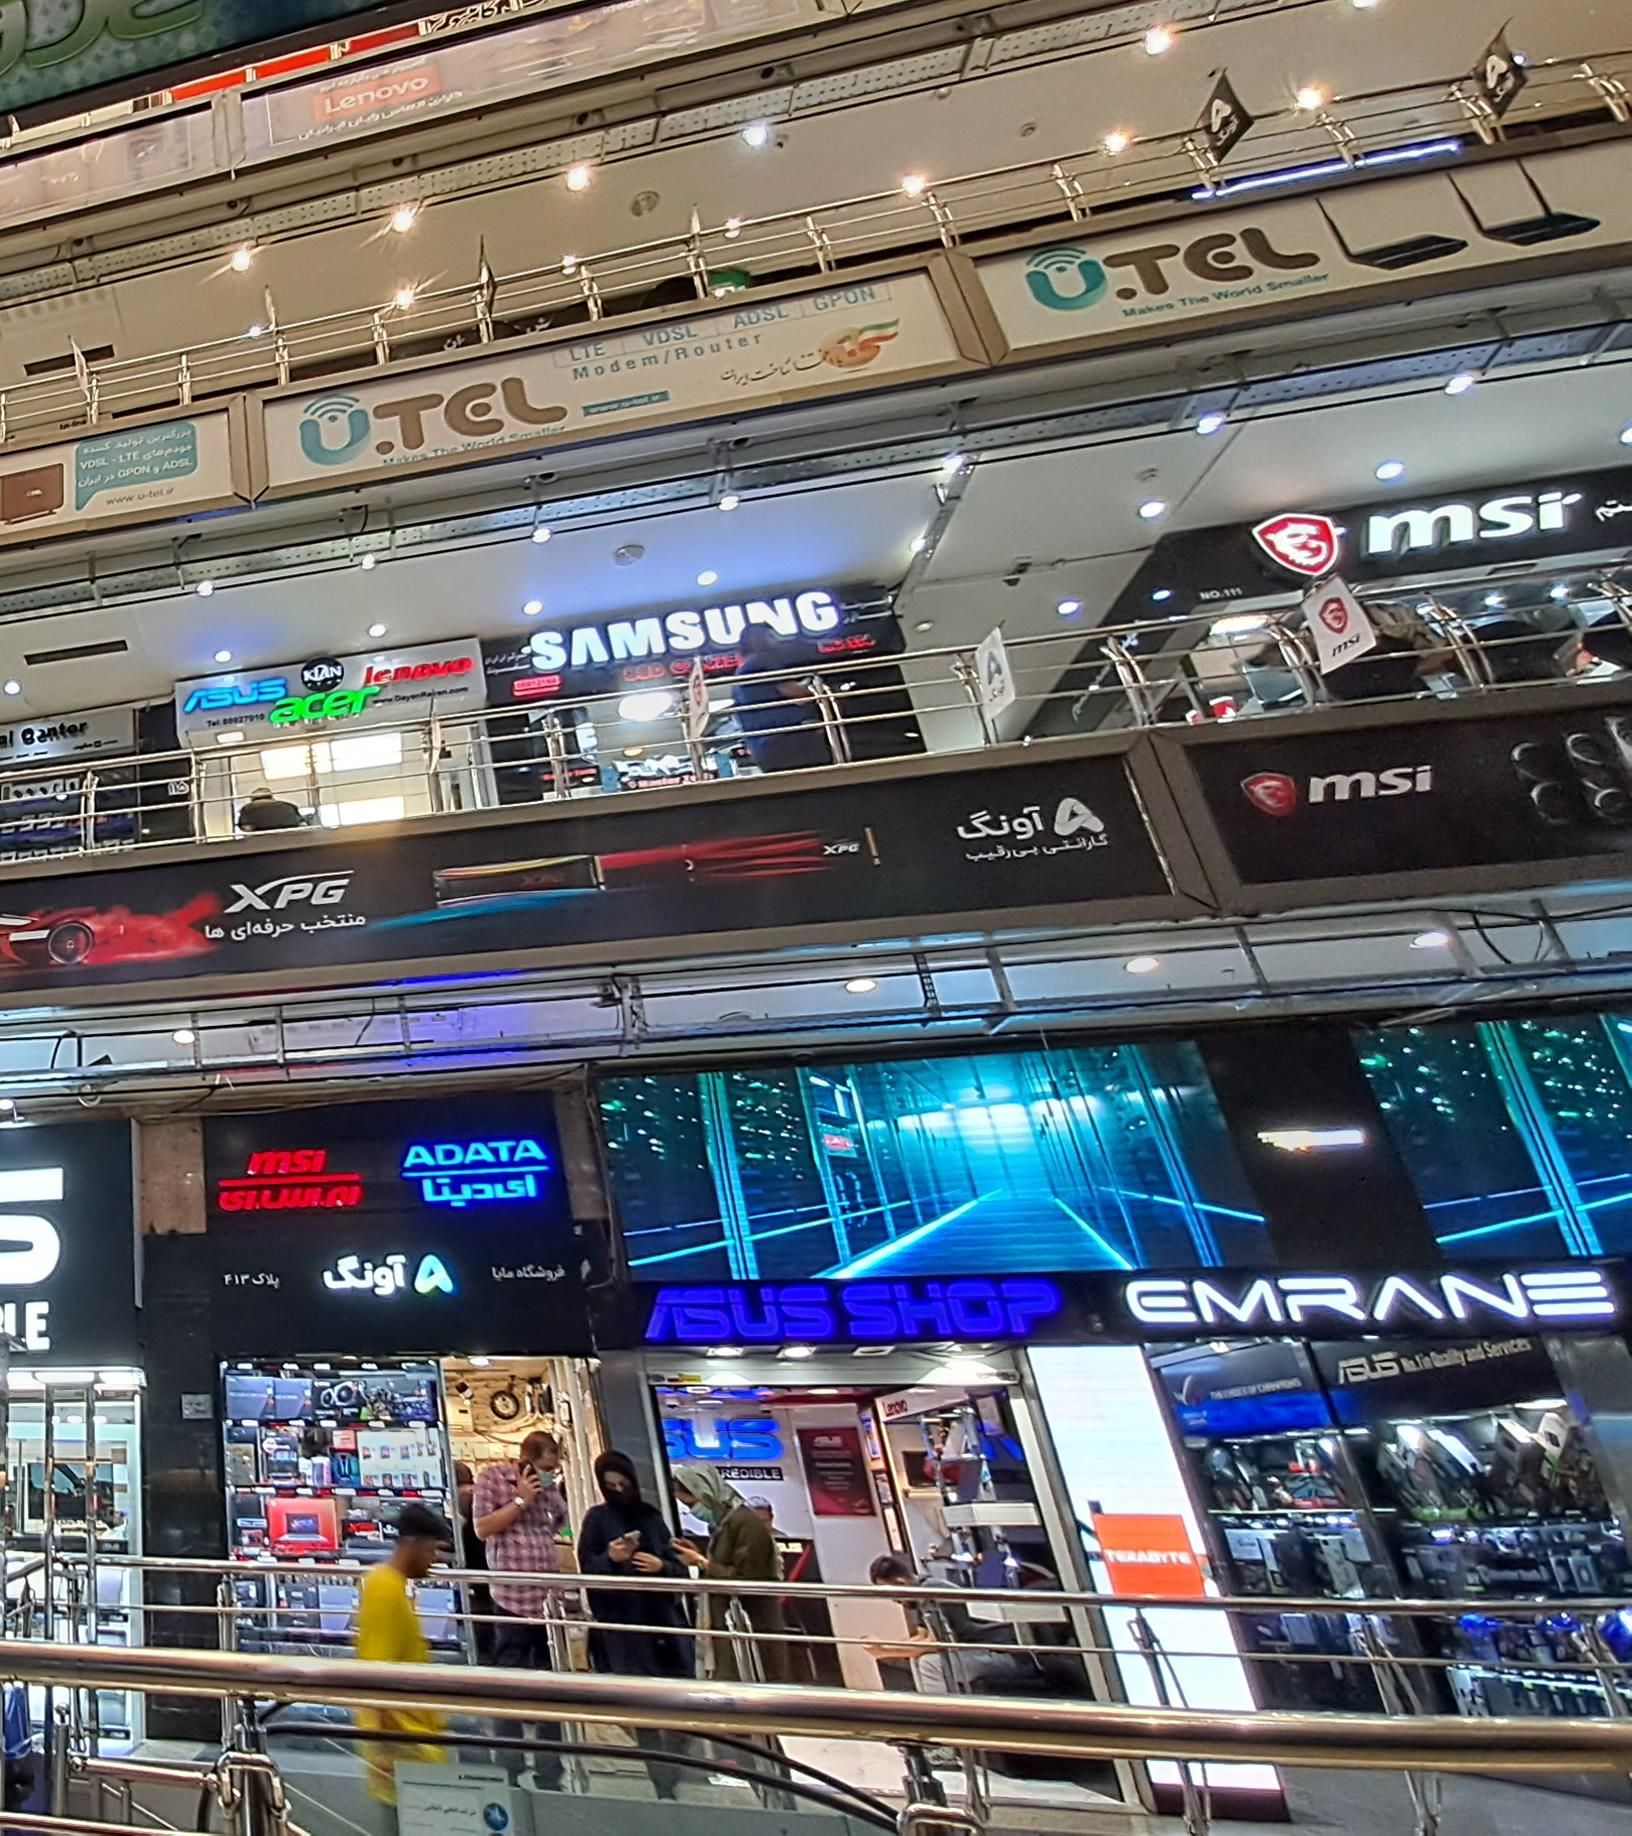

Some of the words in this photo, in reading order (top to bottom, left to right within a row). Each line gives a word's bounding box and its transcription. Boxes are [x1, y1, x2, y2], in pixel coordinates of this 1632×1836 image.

[324, 76, 430, 114] Lenovo
[1122, 303, 1175, 317] Makes
[1178, 295, 1209, 306] The
[1212, 285, 1263, 301] World
[1266, 273, 1330, 291] Smaller
[570, 343, 605, 362] LTE
[642, 326, 697, 347] VDSL
[733, 310, 789, 329] ADSL
[814, 288, 876, 311] GPON
[573, 334, 762, 380] Modem/Router
[432, 446, 458, 458] The
[462, 436, 505, 451] World
[509, 425, 566, 443] Smaller
[80, 458, 109, 469] VDSL
[119, 451, 140, 463] LTE
[118, 466, 150, 478] GPON
[163, 458, 192, 472] ADSL
[1368, 493, 1566, 555] msi
[529, 590, 839, 671] SAMSUNG
[1331, 633, 1362, 658] msi
[364, 657, 475, 685] lenovo
[183, 677, 288, 714] ASUS
[269, 685, 382, 723] acer
[1308, 765, 1433, 803] msi
[956, 805, 1045, 840] آونگ
[823, 841, 860, 856] XPG
[1043, 834, 1109, 855] گارانتی
[224, 870, 355, 914] XPG
[204, 924, 225, 940] ها
[300, 912, 367, 934] منتخب
[247, 1148, 328, 1175] msi
[404, 1139, 548, 1168] ADATA
[251, 1271, 280, 1289] پلاک
[323, 1253, 407, 1296] آونگ
[517, 1264, 566, 1282] فروشگاه
[645, 1286, 834, 1340] ASUS
[843, 1280, 1062, 1338] SHOP
[1125, 1271, 1615, 1324] EMRANE
[1338, 1352, 1400, 1385] ASUS
[1433, 1350, 1466, 1370] Quality
[1465, 1345, 1483, 1362] and
[1483, 1338, 1532, 1360] Services
[882, 1399, 909, 1420] Lenovo
[665, 1417, 784, 1460] SUS
[716, 1466, 783, 1481] REDIBLE
